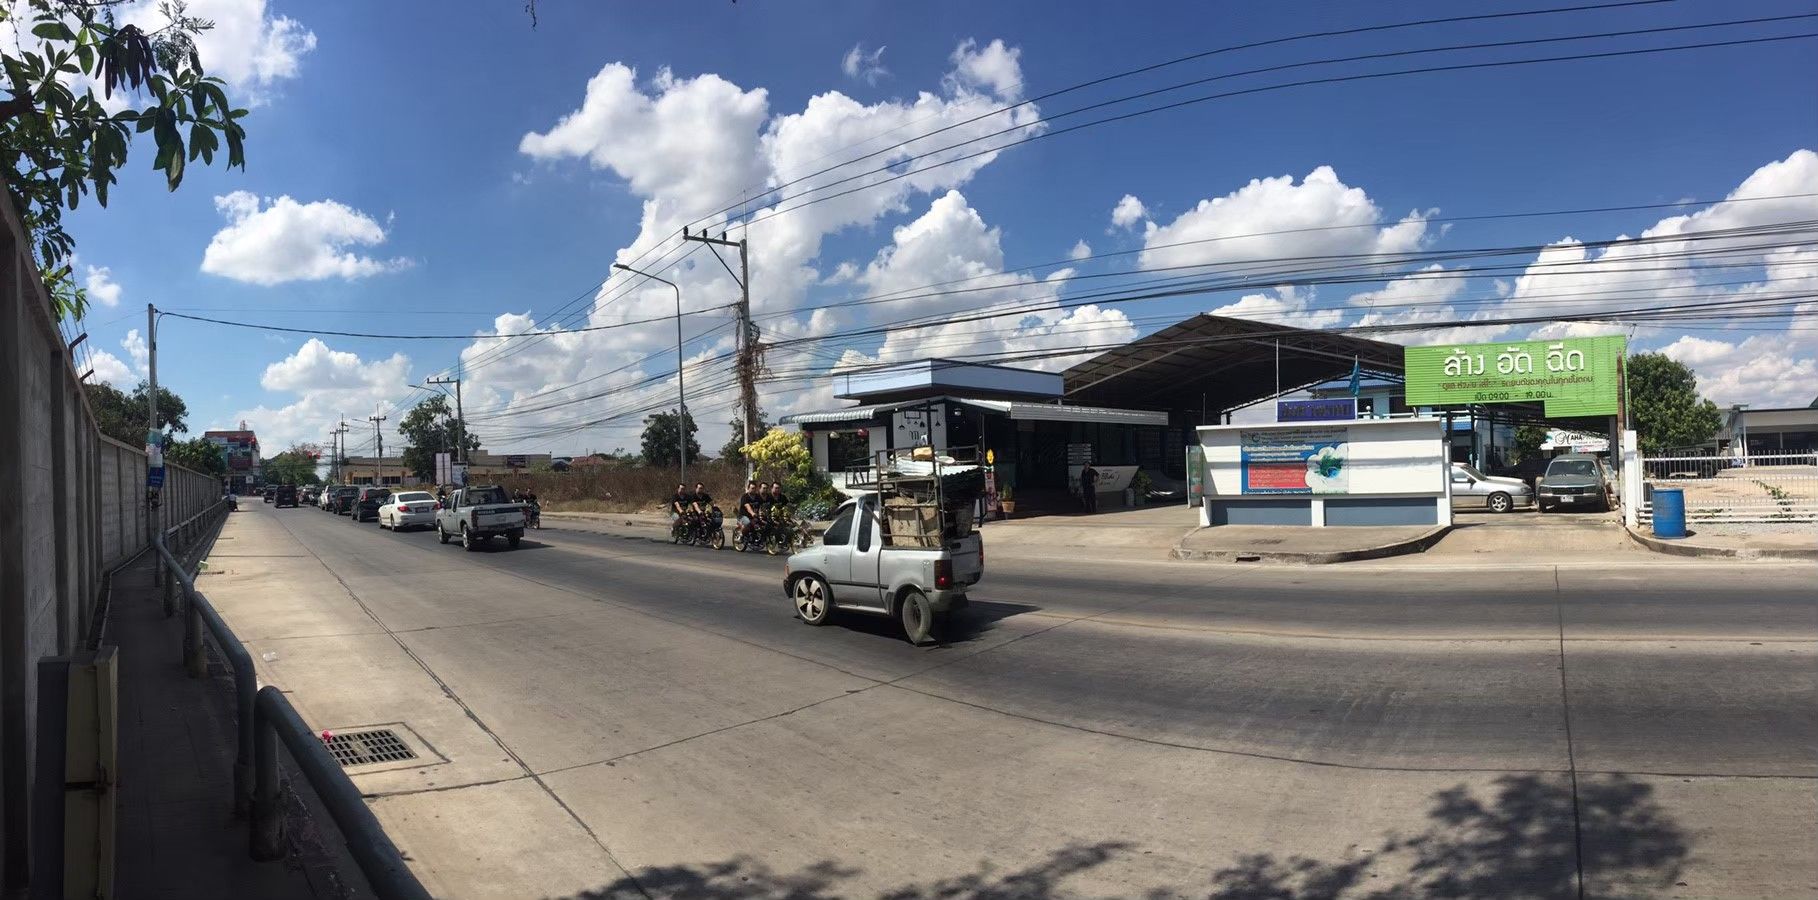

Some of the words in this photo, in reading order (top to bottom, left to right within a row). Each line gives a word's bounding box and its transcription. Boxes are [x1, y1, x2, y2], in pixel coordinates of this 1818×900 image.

[1444, 348, 1485, 376] ล้าง
[1497, 346, 1533, 374] อัด
[1546, 342, 1585, 373] ฉีด
